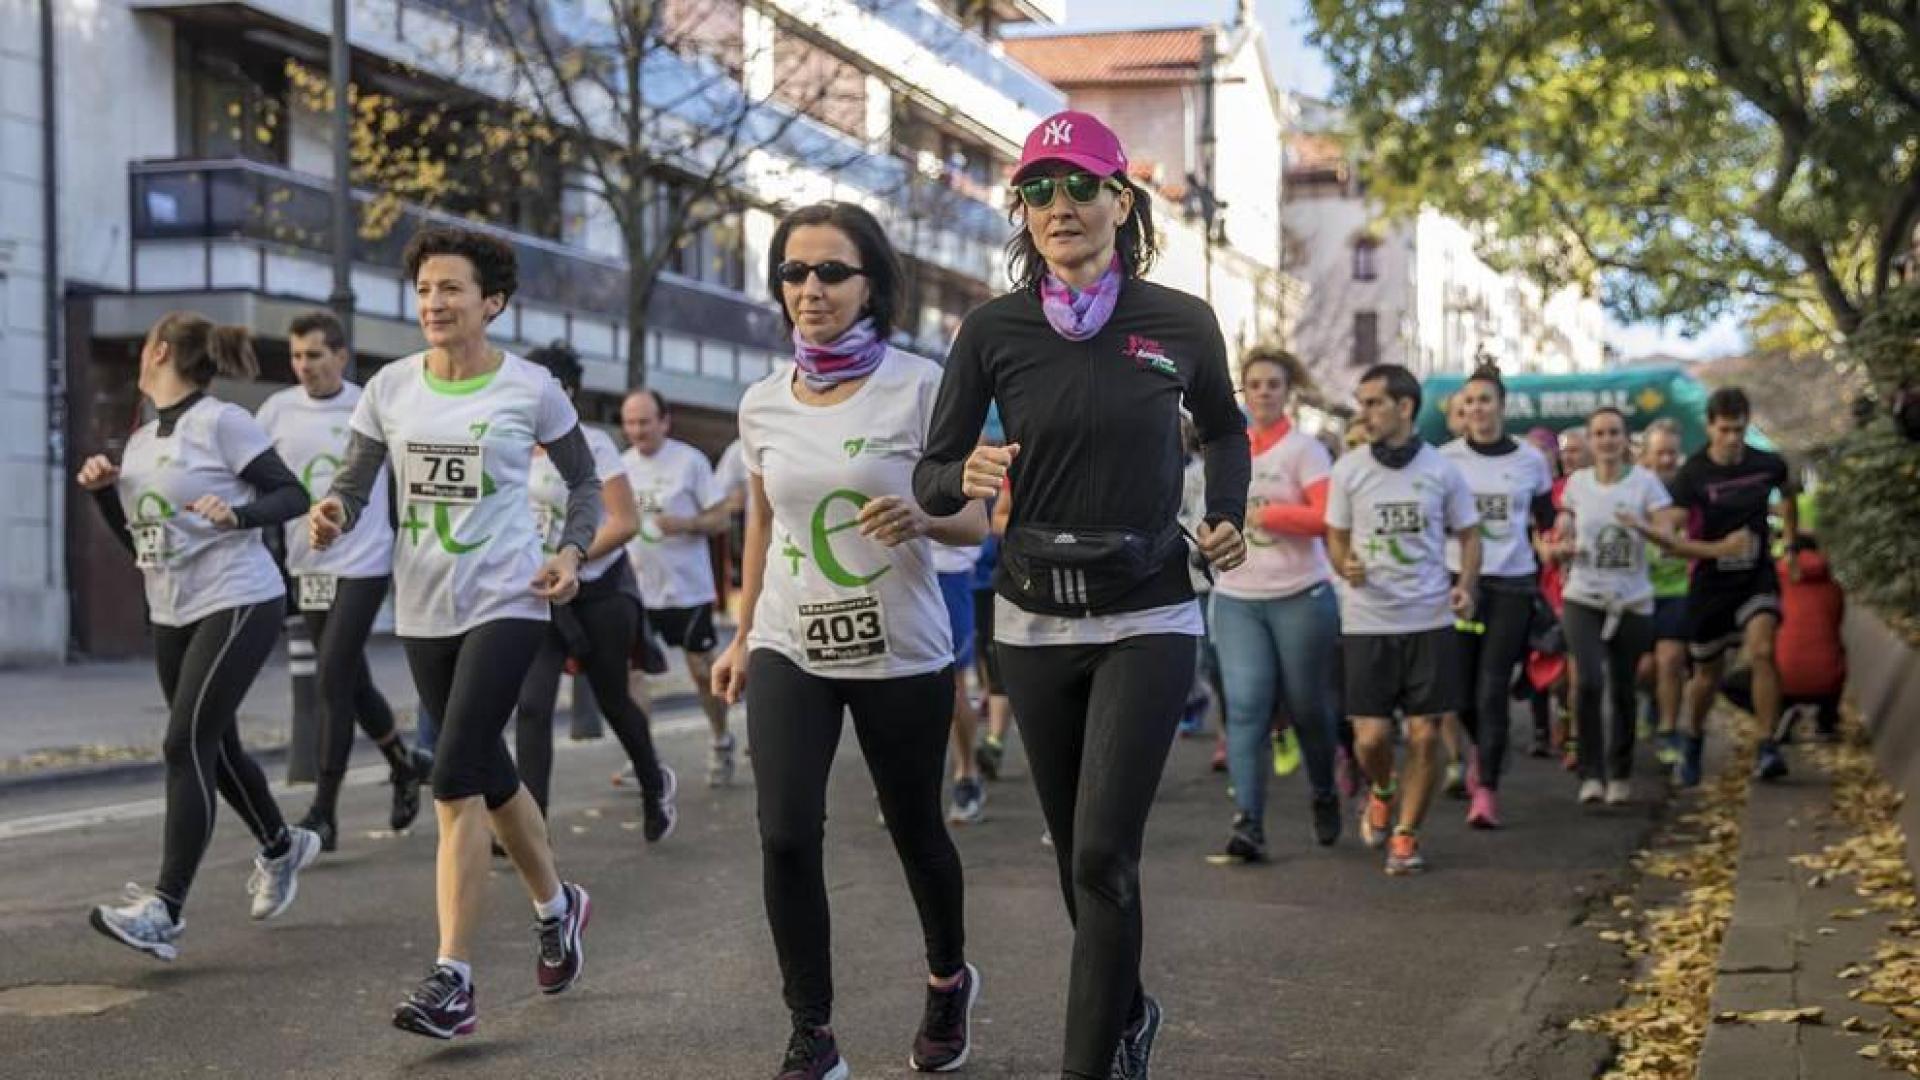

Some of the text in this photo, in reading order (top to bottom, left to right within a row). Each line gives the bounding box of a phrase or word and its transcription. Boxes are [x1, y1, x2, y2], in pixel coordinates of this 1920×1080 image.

[1541, 389, 1635, 418] RURAL
[423, 457, 465, 481] 76
[806, 611, 881, 644] 403
